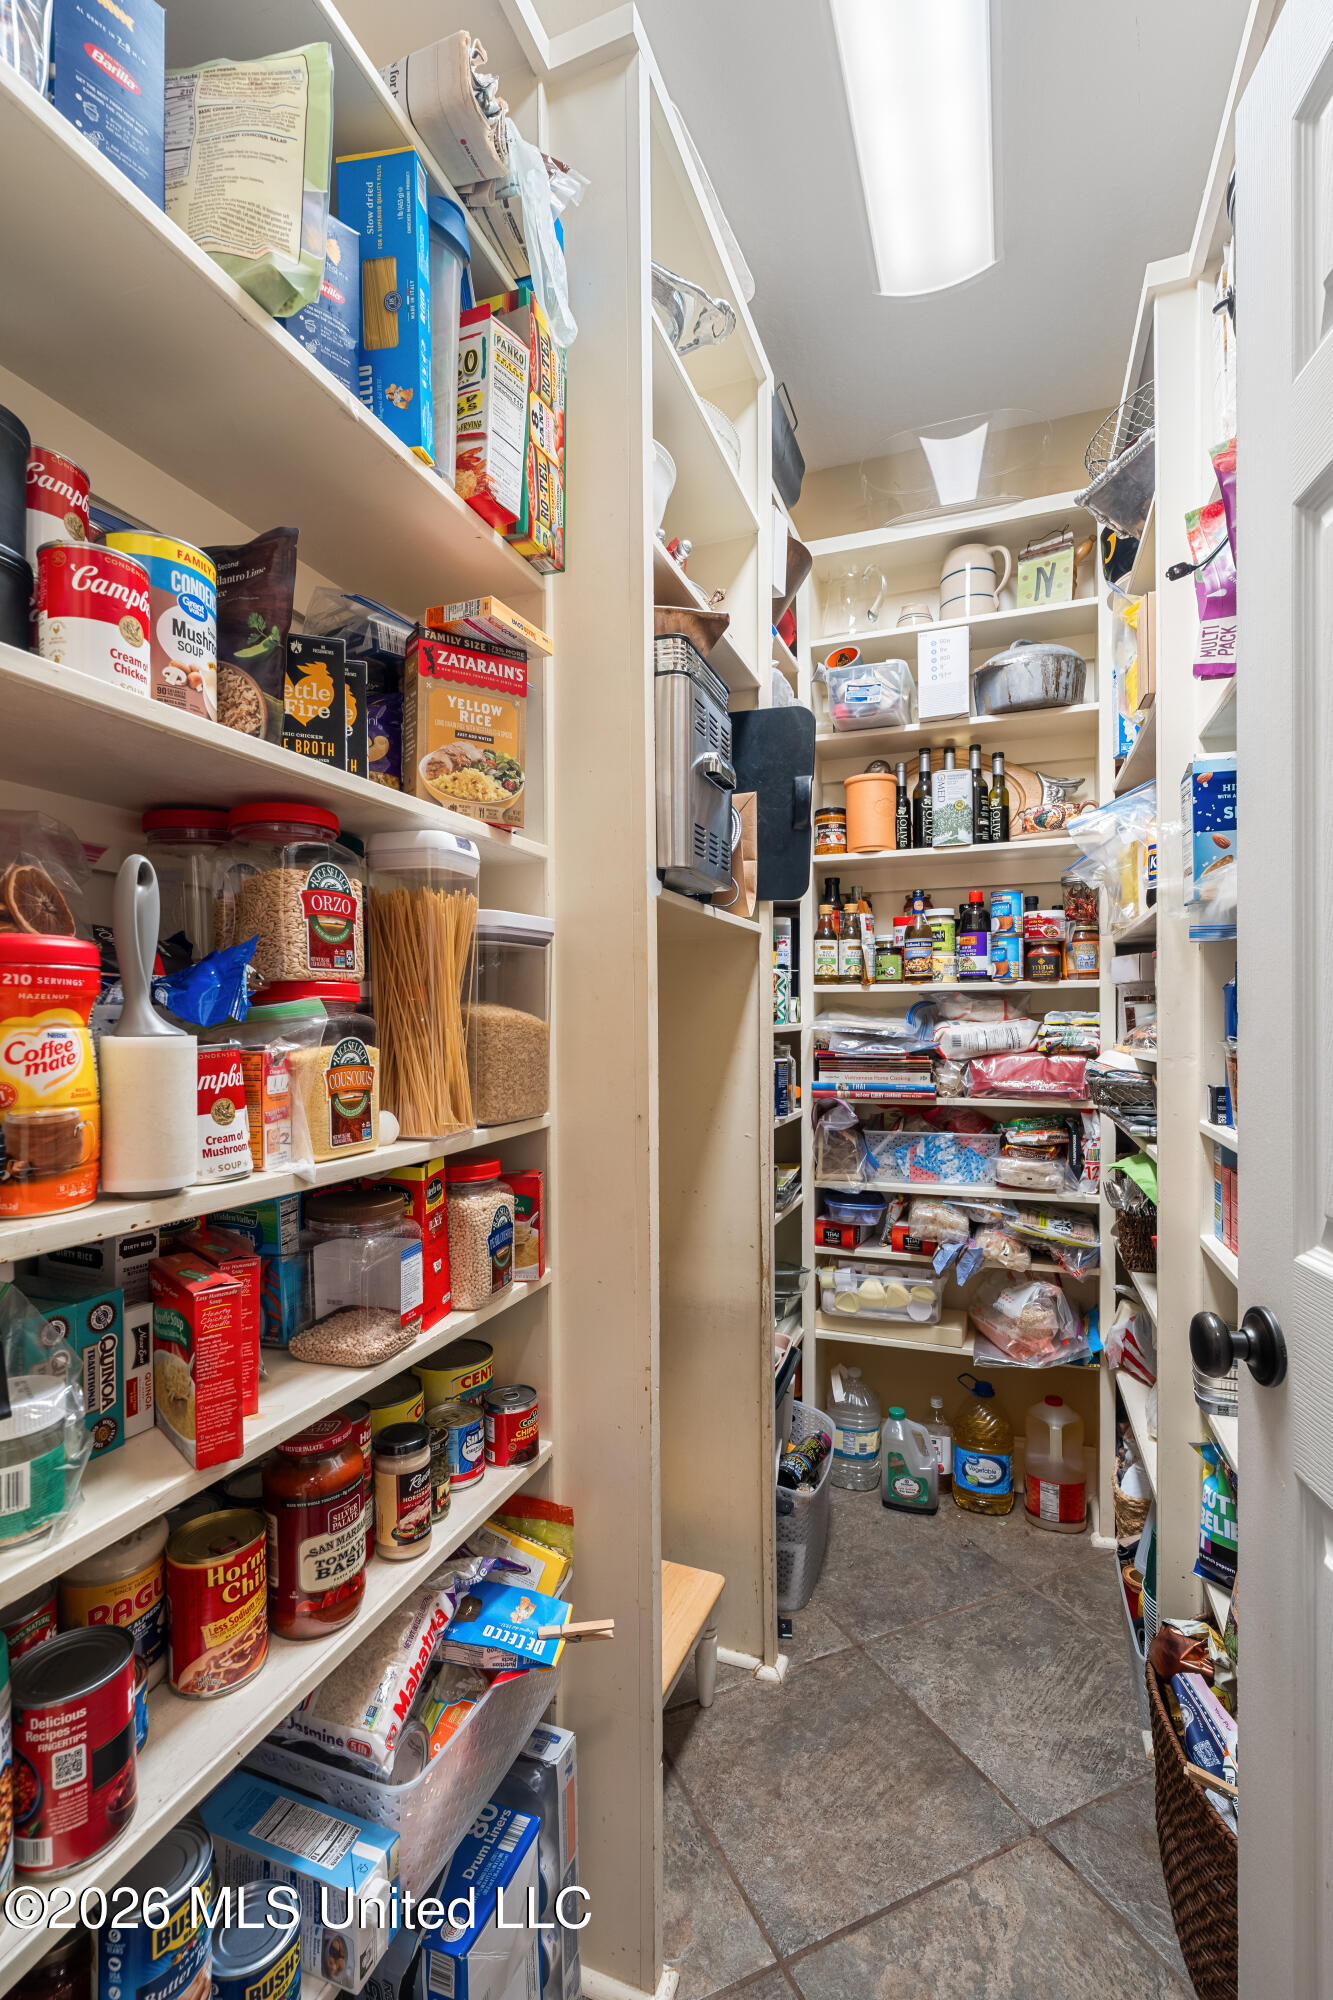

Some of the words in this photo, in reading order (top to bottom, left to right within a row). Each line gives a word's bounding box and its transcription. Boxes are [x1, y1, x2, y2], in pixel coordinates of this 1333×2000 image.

[91, 48, 138, 91] Barilla
[389, 70, 400, 88] for
[366, 181, 374, 209] dried
[366, 211, 375, 235] Slow
[496, 335, 524, 366] PANKO
[531, 409, 539, 429] 8
[176, 548, 213, 574] FAMILY
[217, 560, 240, 572] Second
[216, 572, 246, 587] ilantro
[246, 566, 267, 579] Lime
[1034, 562, 1057, 602] N
[177, 640, 204, 658] SOUP
[424, 629, 462, 648] FAMILY
[463, 638, 488, 653] SIZE
[505, 647, 526, 658] MORE
[1199, 624, 1221, 659] MULTI
[1217, 624, 1237, 657] PACK
[109, 648, 142, 668] Cream
[436, 650, 526, 683] ZATARAIN'S
[113, 661, 149, 684] Chicken
[156, 685, 167, 695] 90
[284, 698, 331, 719] Fire
[447, 695, 504, 717] YELLOW
[458, 709, 493, 728] RICE
[295, 738, 335, 757] BROTH
[310, 894, 352, 915] ORZO
[2, 973, 33, 986] 210
[36, 976, 84, 987] SERVINGS
[18, 992, 71, 1001] HAZELNUT
[3, 1039, 75, 1066] Coffee
[24, 1051, 77, 1078] mate
[328, 1070, 373, 1090] COUSCOUS
[205, 1131, 237, 1146] Cream
[201, 1142, 248, 1160] Mushroom
[217, 1160, 243, 1173] SOUP
[1084, 1165, 1100, 1181] 12
[234, 1215, 256, 1226] Valley
[123, 1243, 140, 1252] DIRTY
[140, 1240, 153, 1249] RICE
[76, 1252, 94, 1263] RICE
[208, 1289, 239, 1300] Homemade
[200, 1314, 233, 1326] Chicken
[203, 1320, 231, 1331] Noodle
[87, 1349, 97, 1409] TRADITIONAL
[99, 1334, 117, 1411] QUINOA
[143, 1371, 152, 1411] QUINOA
[968, 1465, 998, 1476] Vegetable
[331, 1511, 360, 1532] PALATE
[332, 1503, 359, 1523] SILVER
[303, 1538, 335, 1562] SAN
[1215, 1560, 1237, 1575] popcorn
[25, 1613, 51, 1634] NATURAL
[208, 1621, 229, 1637] Less
[228, 1602, 256, 1626] Sodium
[482, 1624, 525, 1650] CECCO
[523, 1637, 547, 1656] DE
[492, 1661, 517, 1669] Nutrition
[29, 1706, 88, 1731] Delicious
[25, 1726, 71, 1743] Recipes
[37, 1730, 88, 1753] FINGERTIPS
[287, 1716, 345, 1748] Jasmine
[461, 1844, 493, 1881] Drum
[486, 1807, 514, 1849] Liners
[309, 1851, 320, 1861] 10
